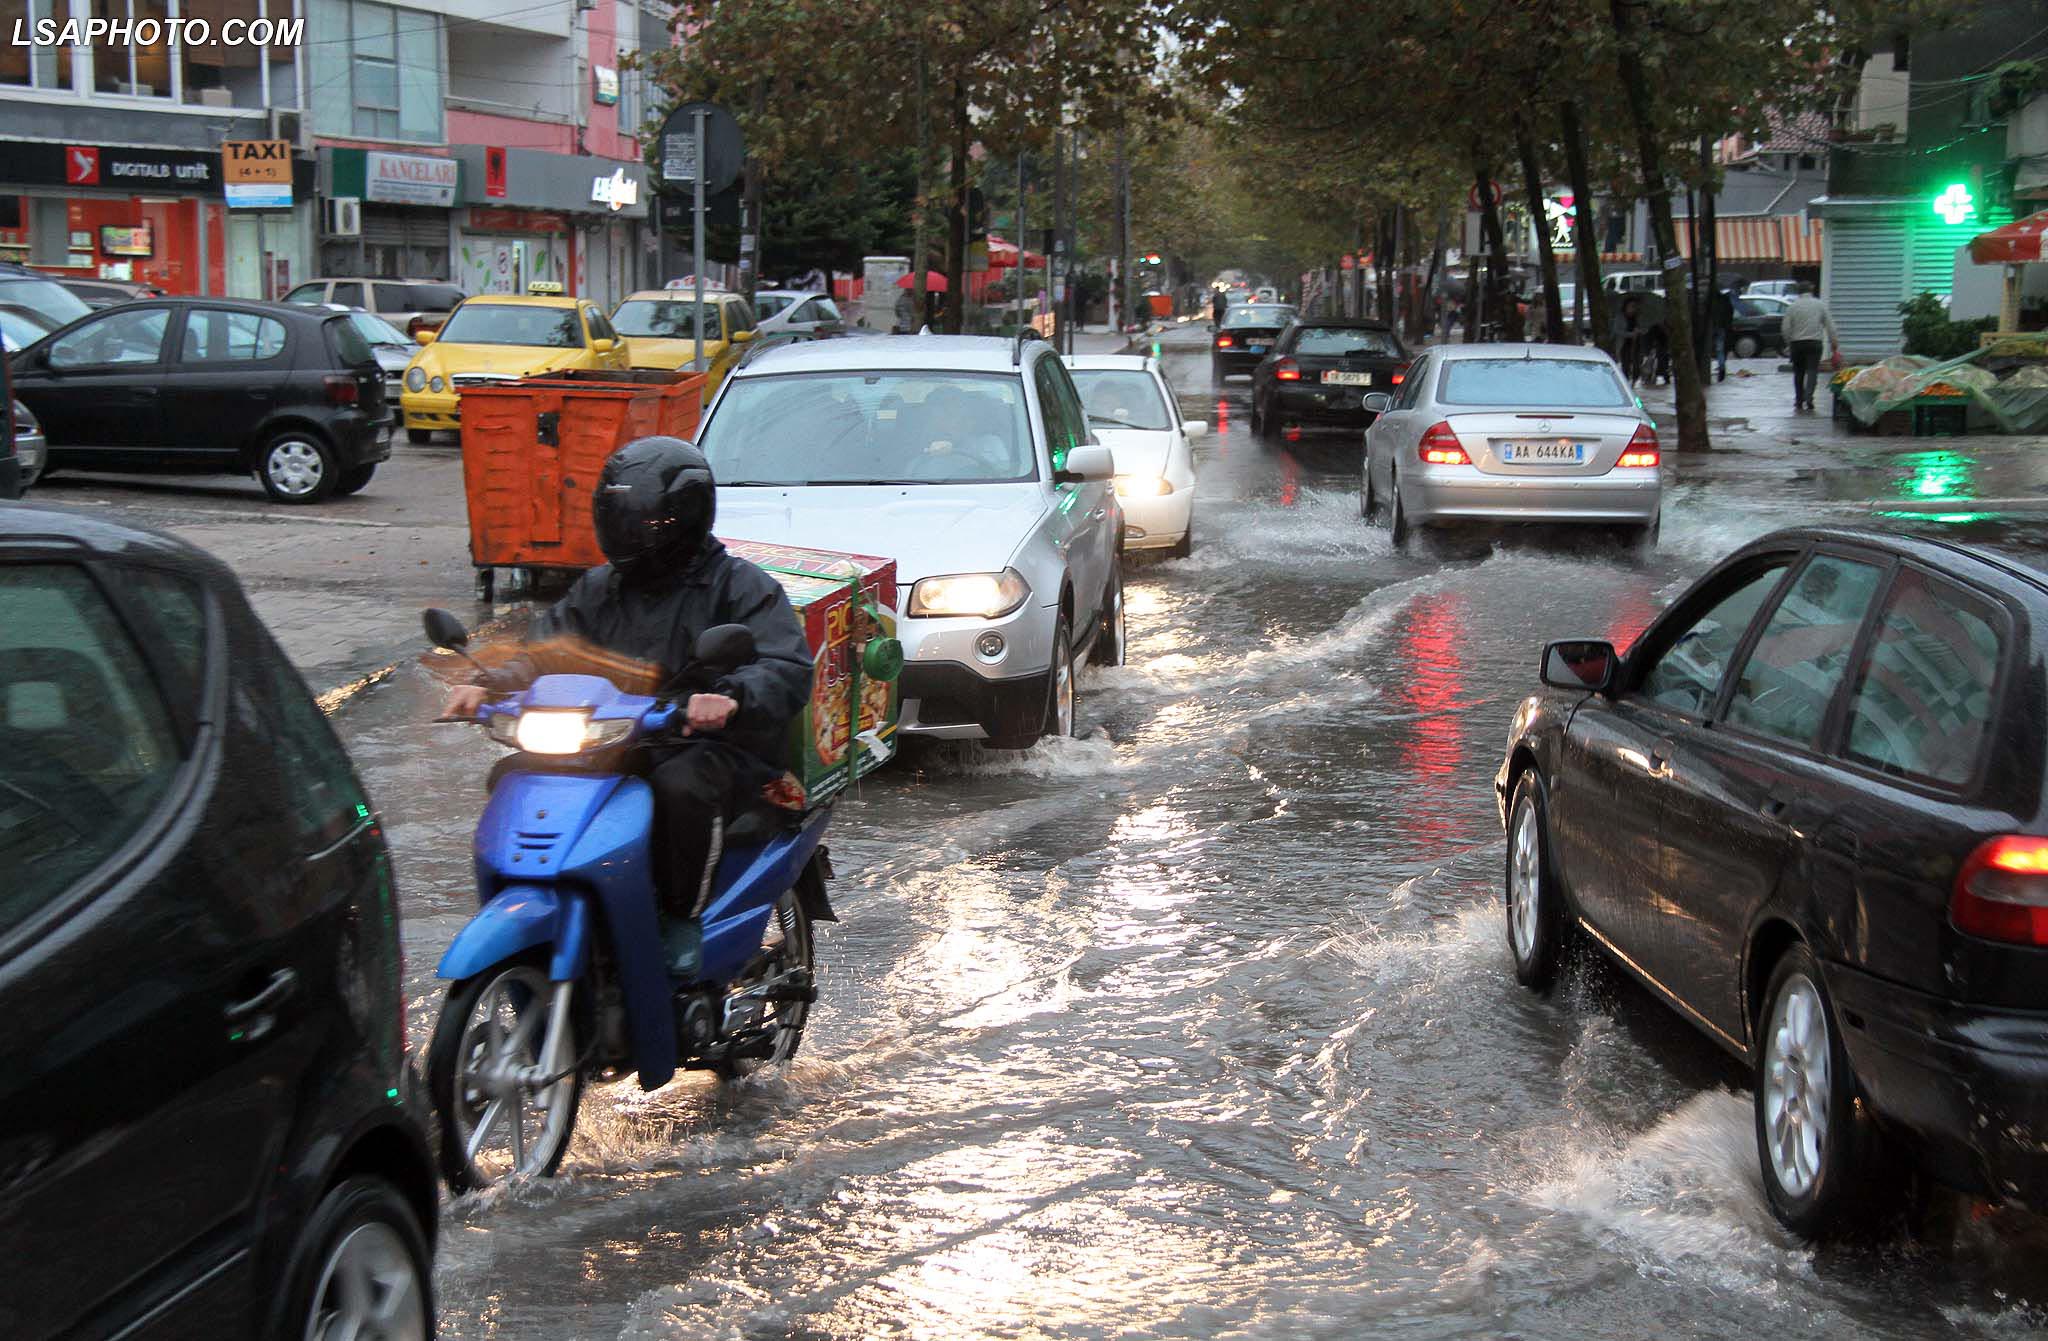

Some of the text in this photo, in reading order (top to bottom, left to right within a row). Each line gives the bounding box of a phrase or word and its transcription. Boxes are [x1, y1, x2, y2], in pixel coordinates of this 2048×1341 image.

[227, 143, 285, 159] TAXI
[1515, 445, 1575, 458] AA 644KA
